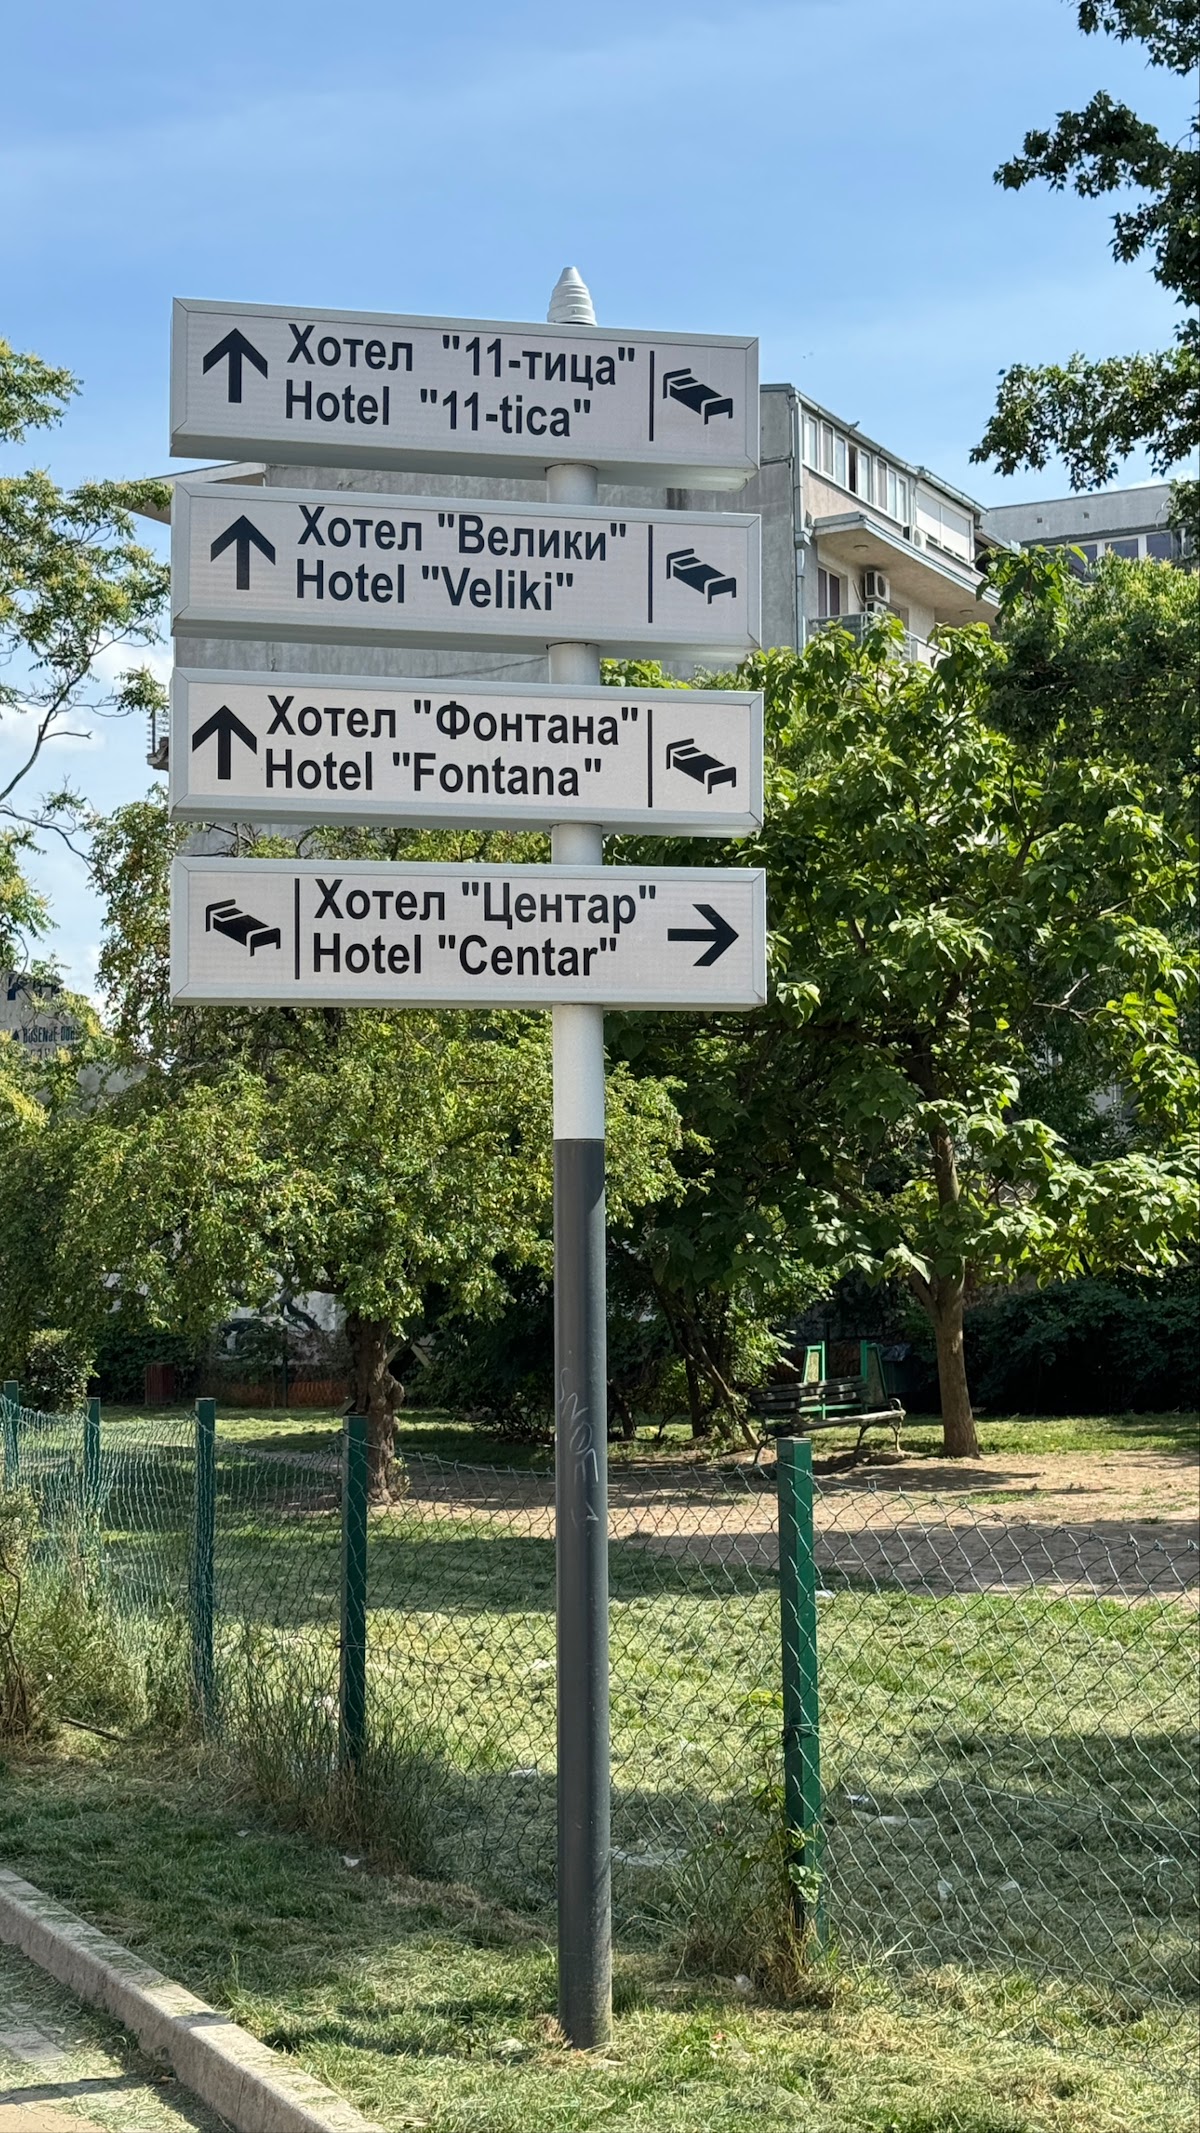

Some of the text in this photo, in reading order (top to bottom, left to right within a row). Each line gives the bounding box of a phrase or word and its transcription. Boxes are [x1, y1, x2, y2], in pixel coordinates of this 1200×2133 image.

[287, 324, 635, 391] Хотел "11-тица"
[286, 379, 590, 437] Hotel "11-tica"
[298, 505, 626, 561] Хотел "Велики"
[297, 559, 573, 610] Hotel "Veliki"
[267, 695, 637, 745] Хотел "Фонтана"
[266, 749, 601, 796] Hotel "Fontana"
[314, 879, 655, 934] Хотел "Центар"
[314, 933, 616, 976] Hotel "Centar"
